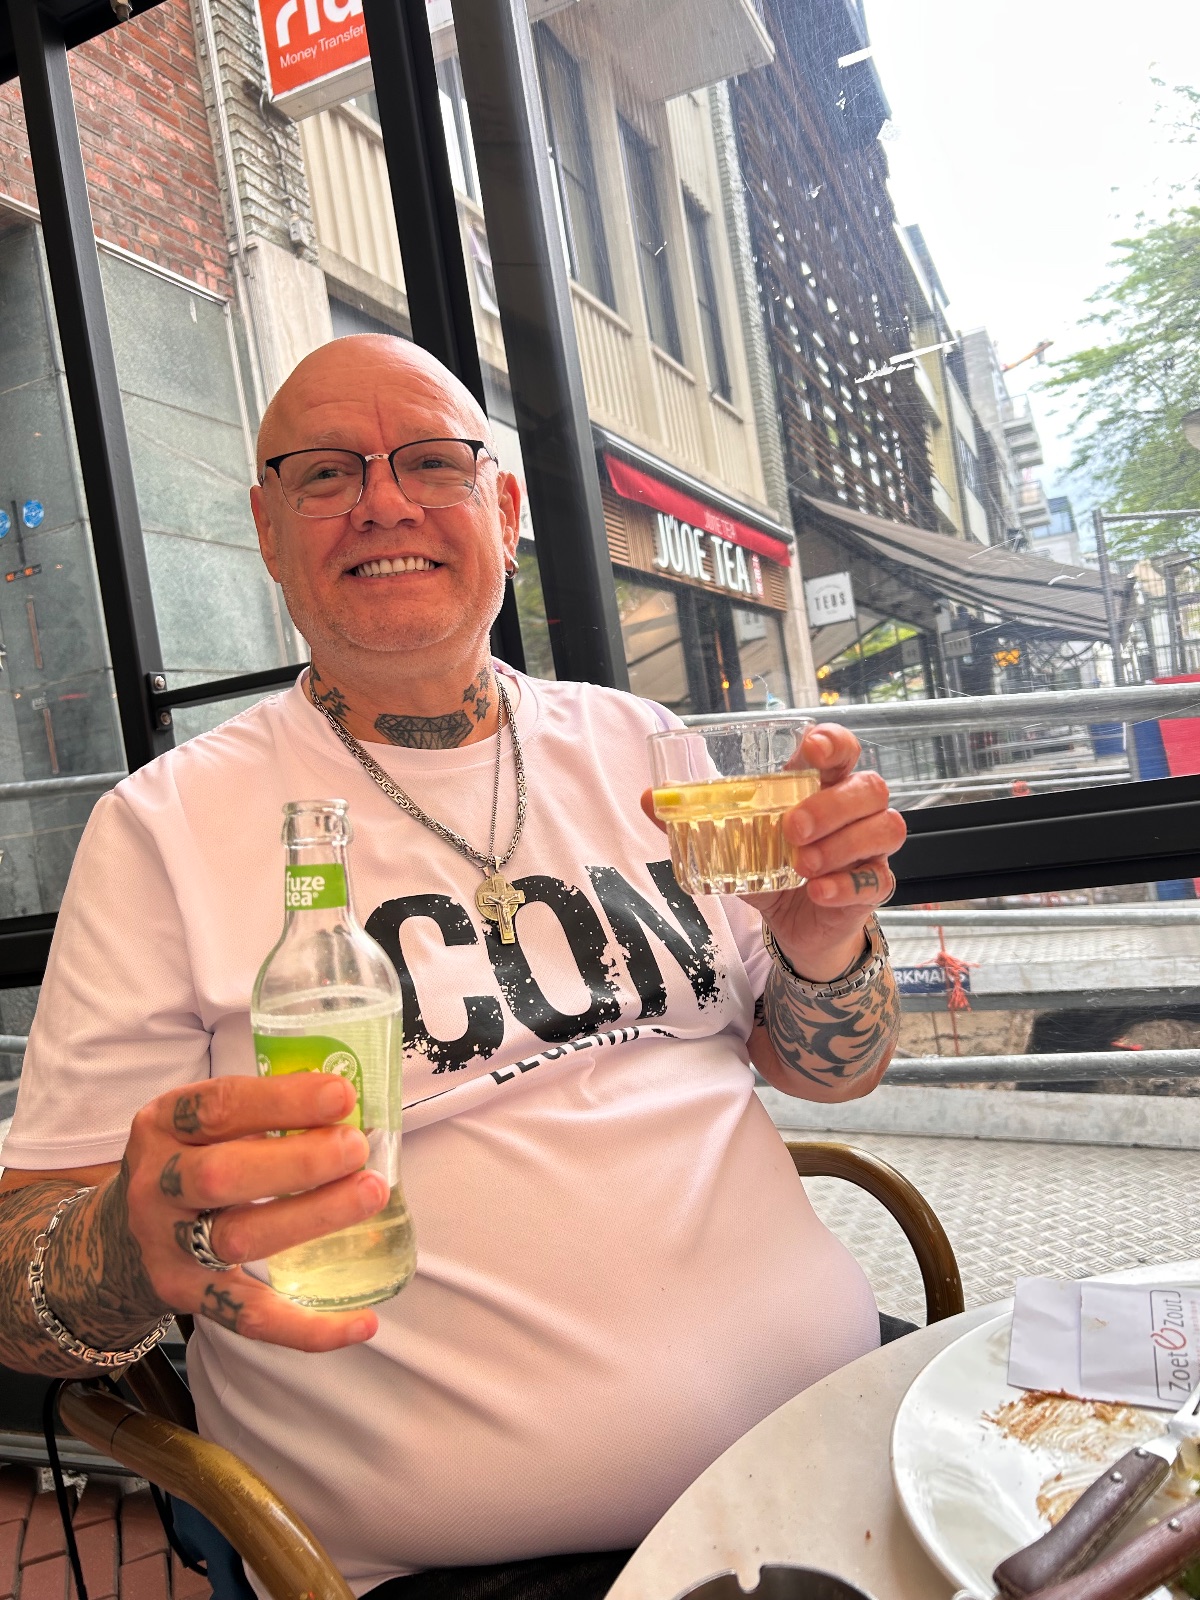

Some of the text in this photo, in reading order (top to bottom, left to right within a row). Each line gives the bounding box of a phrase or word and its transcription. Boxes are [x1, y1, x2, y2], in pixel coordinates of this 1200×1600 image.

[279, 24, 366, 69] Money Transfer
[710, 535, 752, 594] TEA
[286, 871, 326, 892] fuze
[1163, 1299, 1185, 1328] Zout
[1168, 1351, 1192, 1393] Zoet
